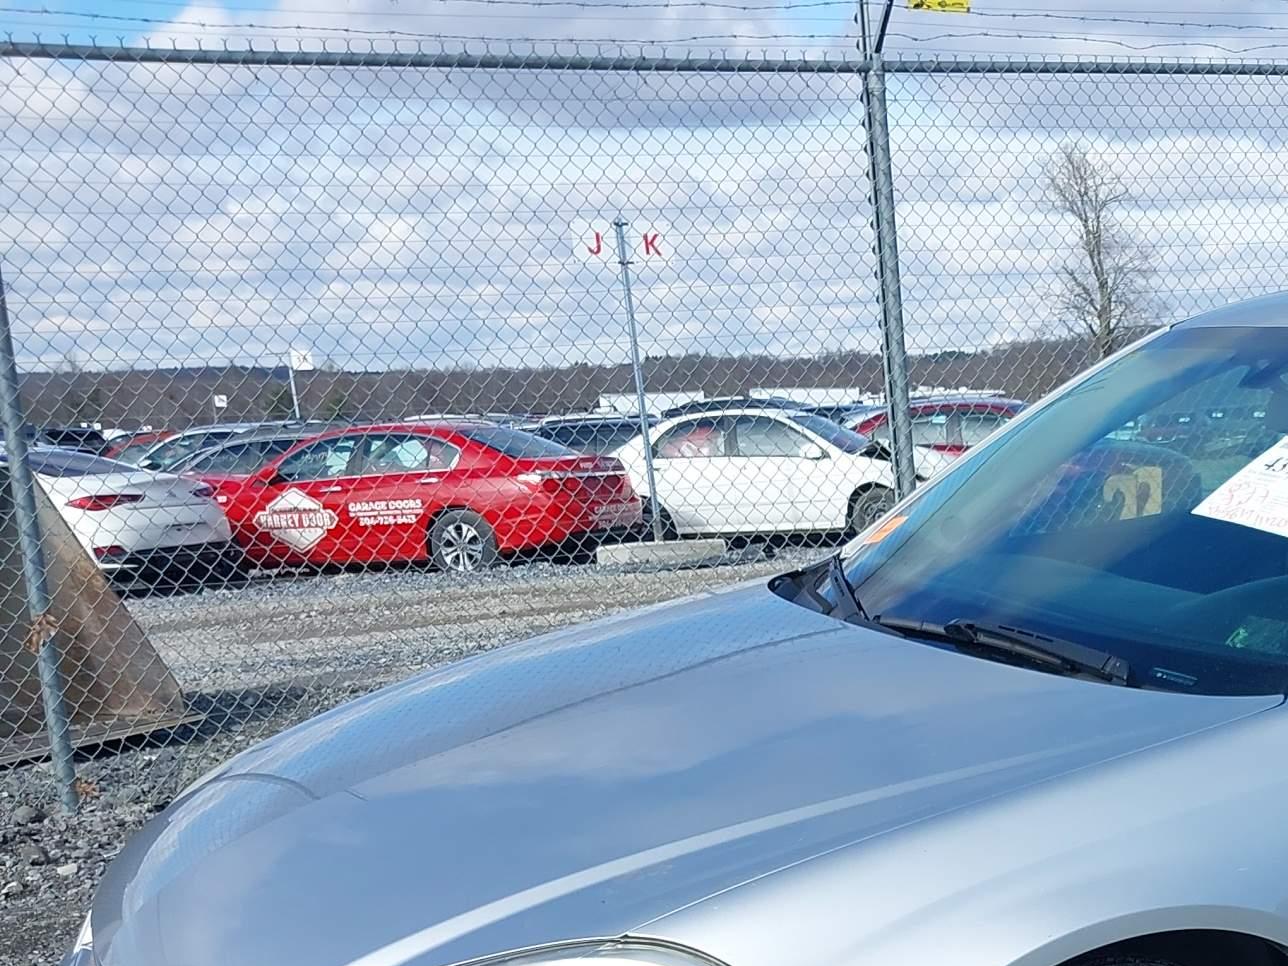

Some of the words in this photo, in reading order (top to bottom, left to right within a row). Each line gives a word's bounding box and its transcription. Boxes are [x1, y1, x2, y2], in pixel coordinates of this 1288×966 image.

[586, 232, 601, 255] J
[642, 233, 662, 256] K
[348, 501, 388, 511] GARAGE
[388, 499, 422, 509] DOORS
